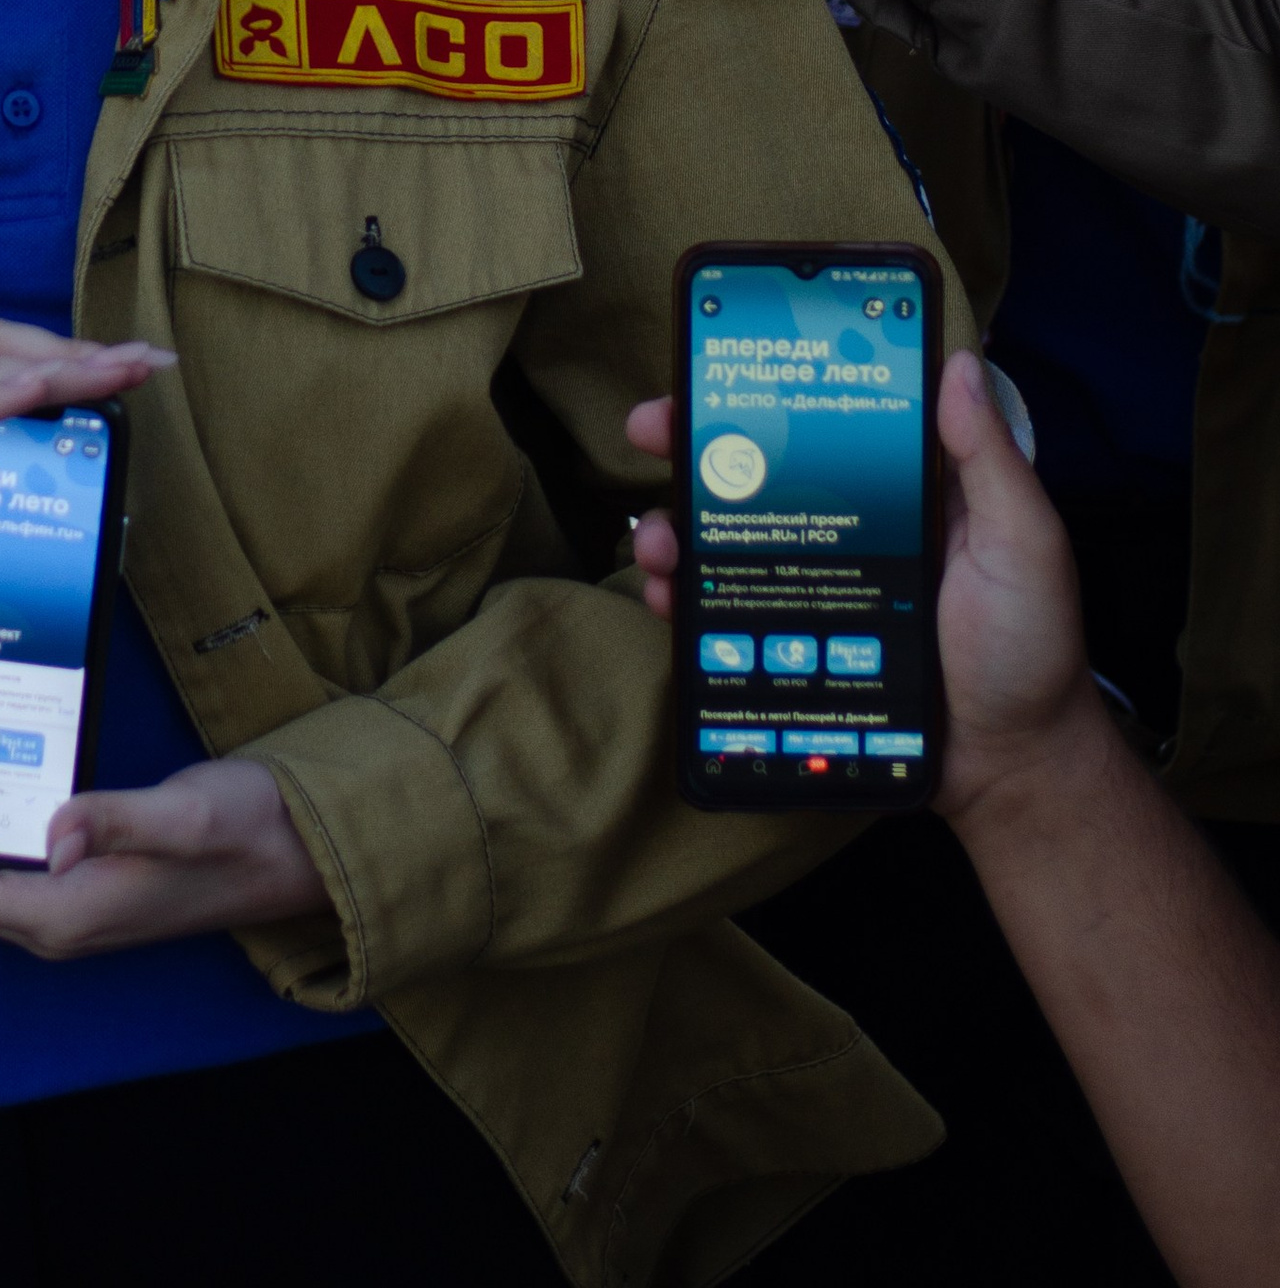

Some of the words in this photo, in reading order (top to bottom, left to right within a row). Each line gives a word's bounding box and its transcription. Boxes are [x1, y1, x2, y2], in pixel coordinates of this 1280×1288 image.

[705, 338, 829, 362] впереди
[705, 362, 814, 386] лучшее
[822, 364, 891, 383] лето
[727, 393, 775, 407] ВСПО
[781, 393, 909, 413] «Дельфин.ru»
[7, 492, 70, 516] лето
[700, 510, 807, 526] Всероссийский
[809, 513, 859, 527] проект
[700, 527, 798, 544] «Дельфин.RU»
[807, 530, 838, 542] РСО
